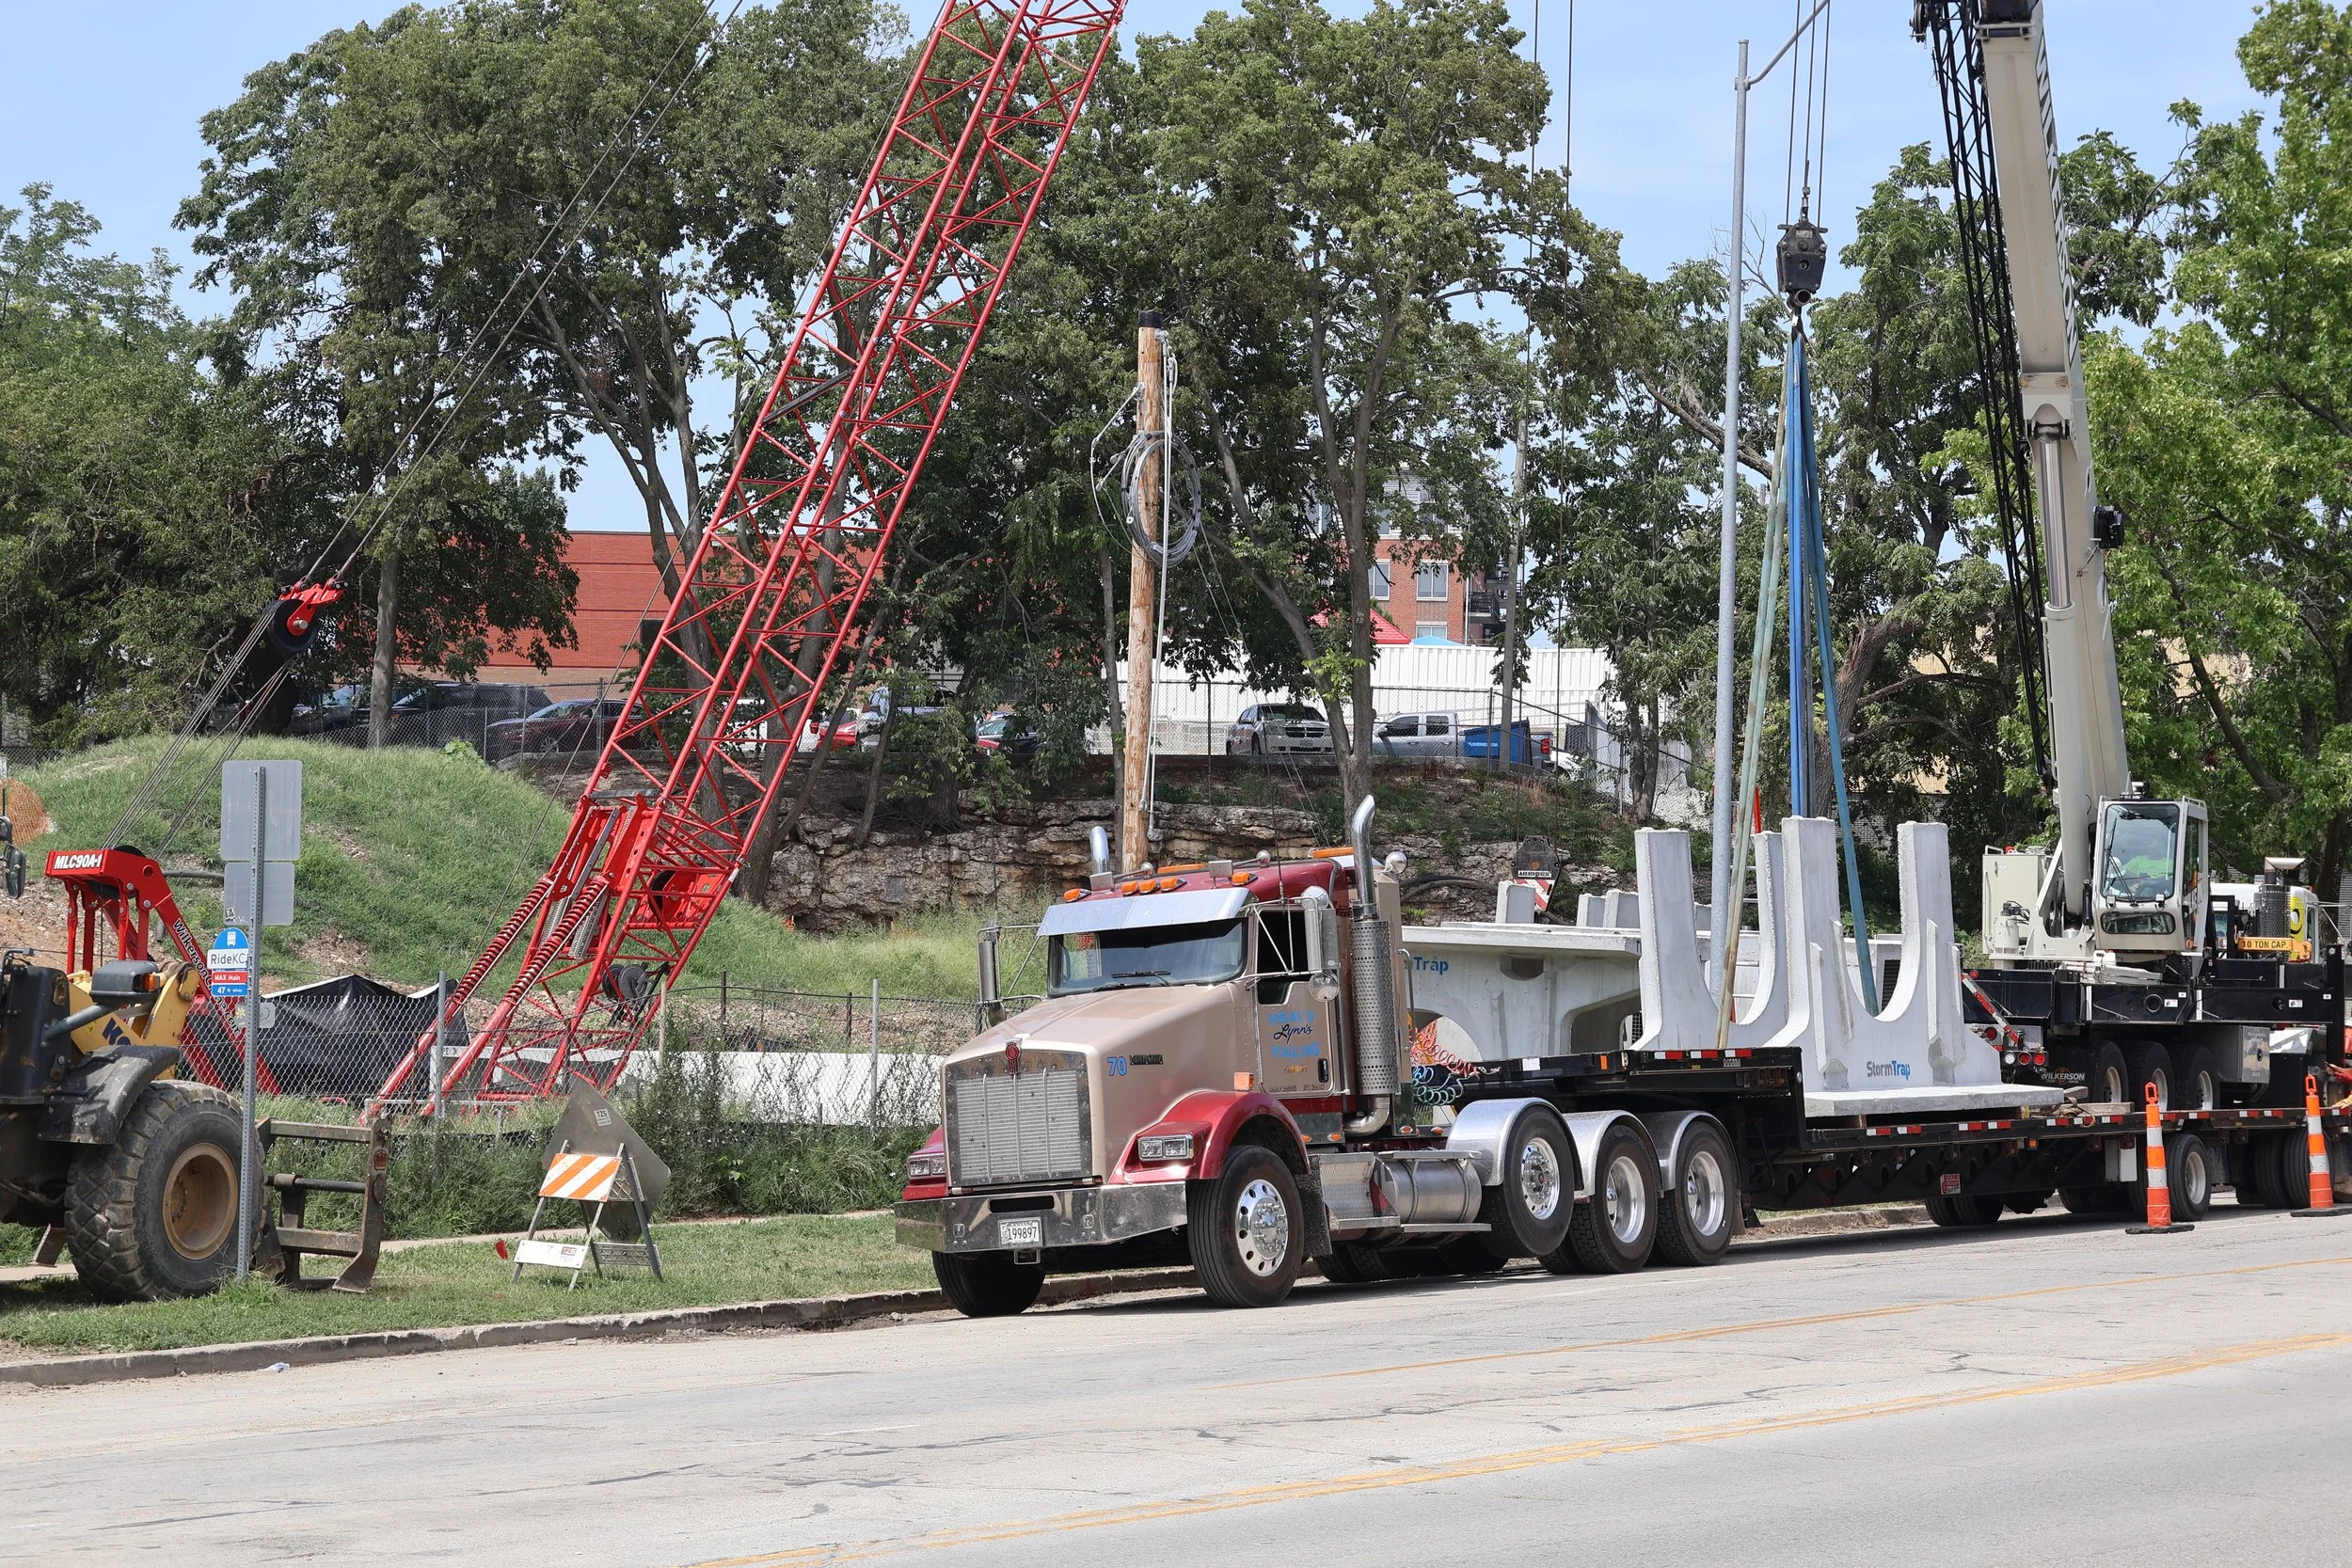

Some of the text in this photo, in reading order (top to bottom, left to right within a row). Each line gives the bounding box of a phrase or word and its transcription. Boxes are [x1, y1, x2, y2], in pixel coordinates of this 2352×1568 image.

[2035, 30, 2078, 366] WILKERSON
[54, 853, 103, 869] MLC90A-1
[211, 952, 245, 964] RideKC
[1273, 1023, 1313, 1044] Lynn's
[1106, 1055, 1127, 1076] 70
[1866, 1059, 1911, 1081] StormTrap
[2041, 1072, 2085, 1081] WILKERSON
[1008, 1227, 1037, 1241] 199897
